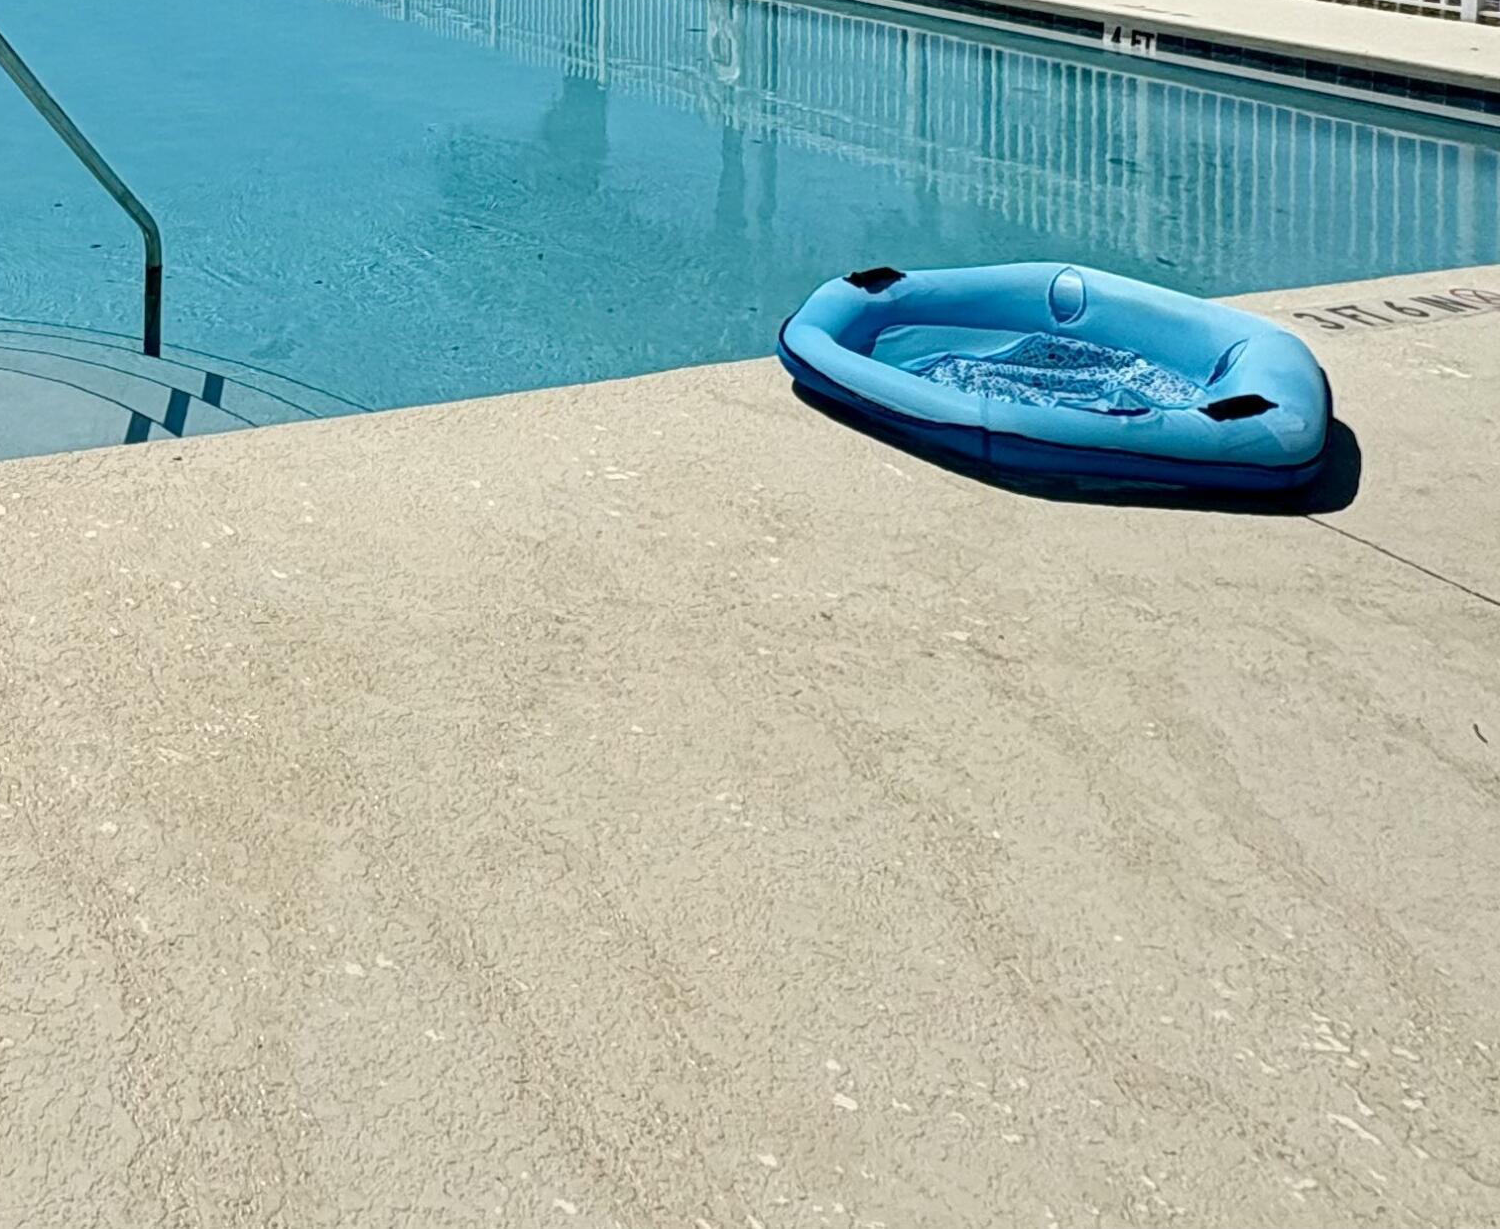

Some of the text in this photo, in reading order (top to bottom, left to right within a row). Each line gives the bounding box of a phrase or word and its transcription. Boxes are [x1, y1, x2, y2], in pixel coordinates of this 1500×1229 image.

[1111, 26, 1155, 50] 4 FT
[1293, 294, 1482, 330] 3 FT 6 IN
